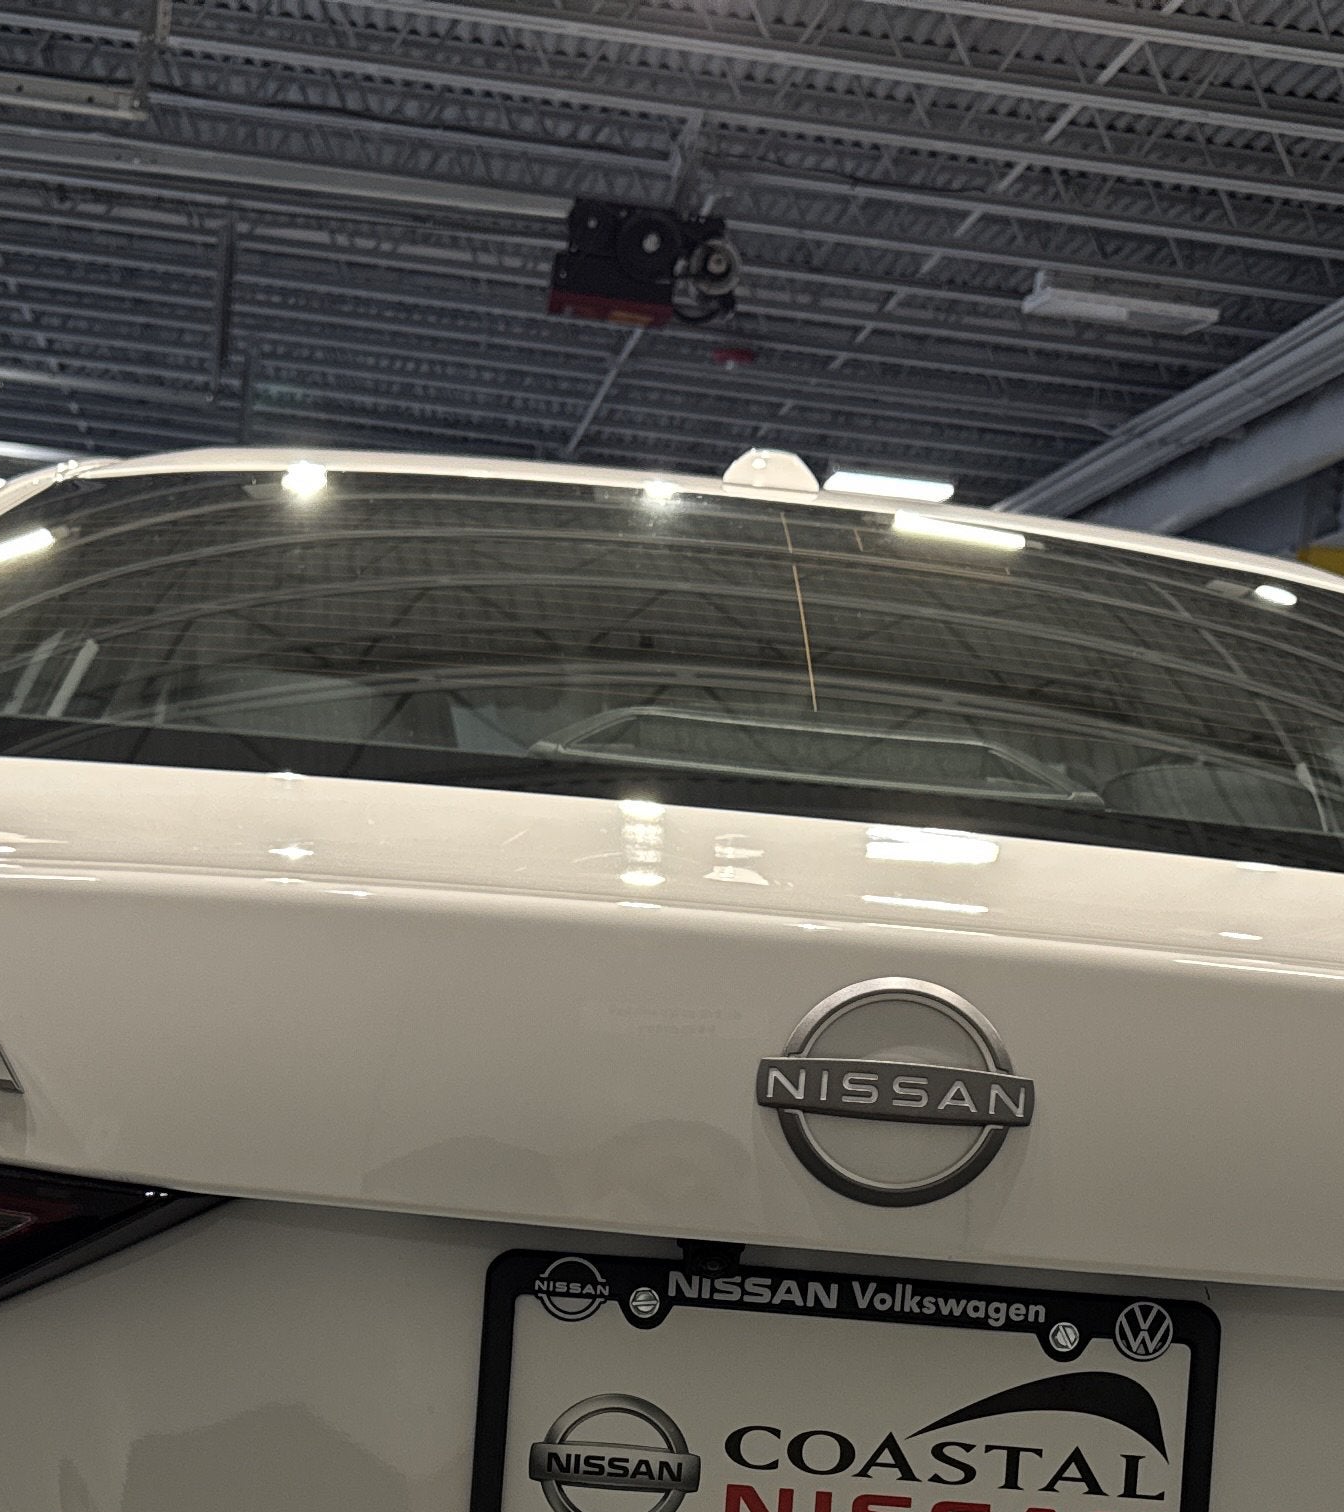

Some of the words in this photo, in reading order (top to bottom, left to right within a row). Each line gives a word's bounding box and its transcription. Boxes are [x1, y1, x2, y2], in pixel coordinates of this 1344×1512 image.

[766, 1067, 1026, 1118] NISSAN
[535, 1280, 609, 1296] NISSAN
[667, 1270, 839, 1309] NISSAN
[852, 1281, 1046, 1327] Volkswagen
[546, 1452, 683, 1482] NISSAN
[724, 1425, 1165, 1501] COASTAL
